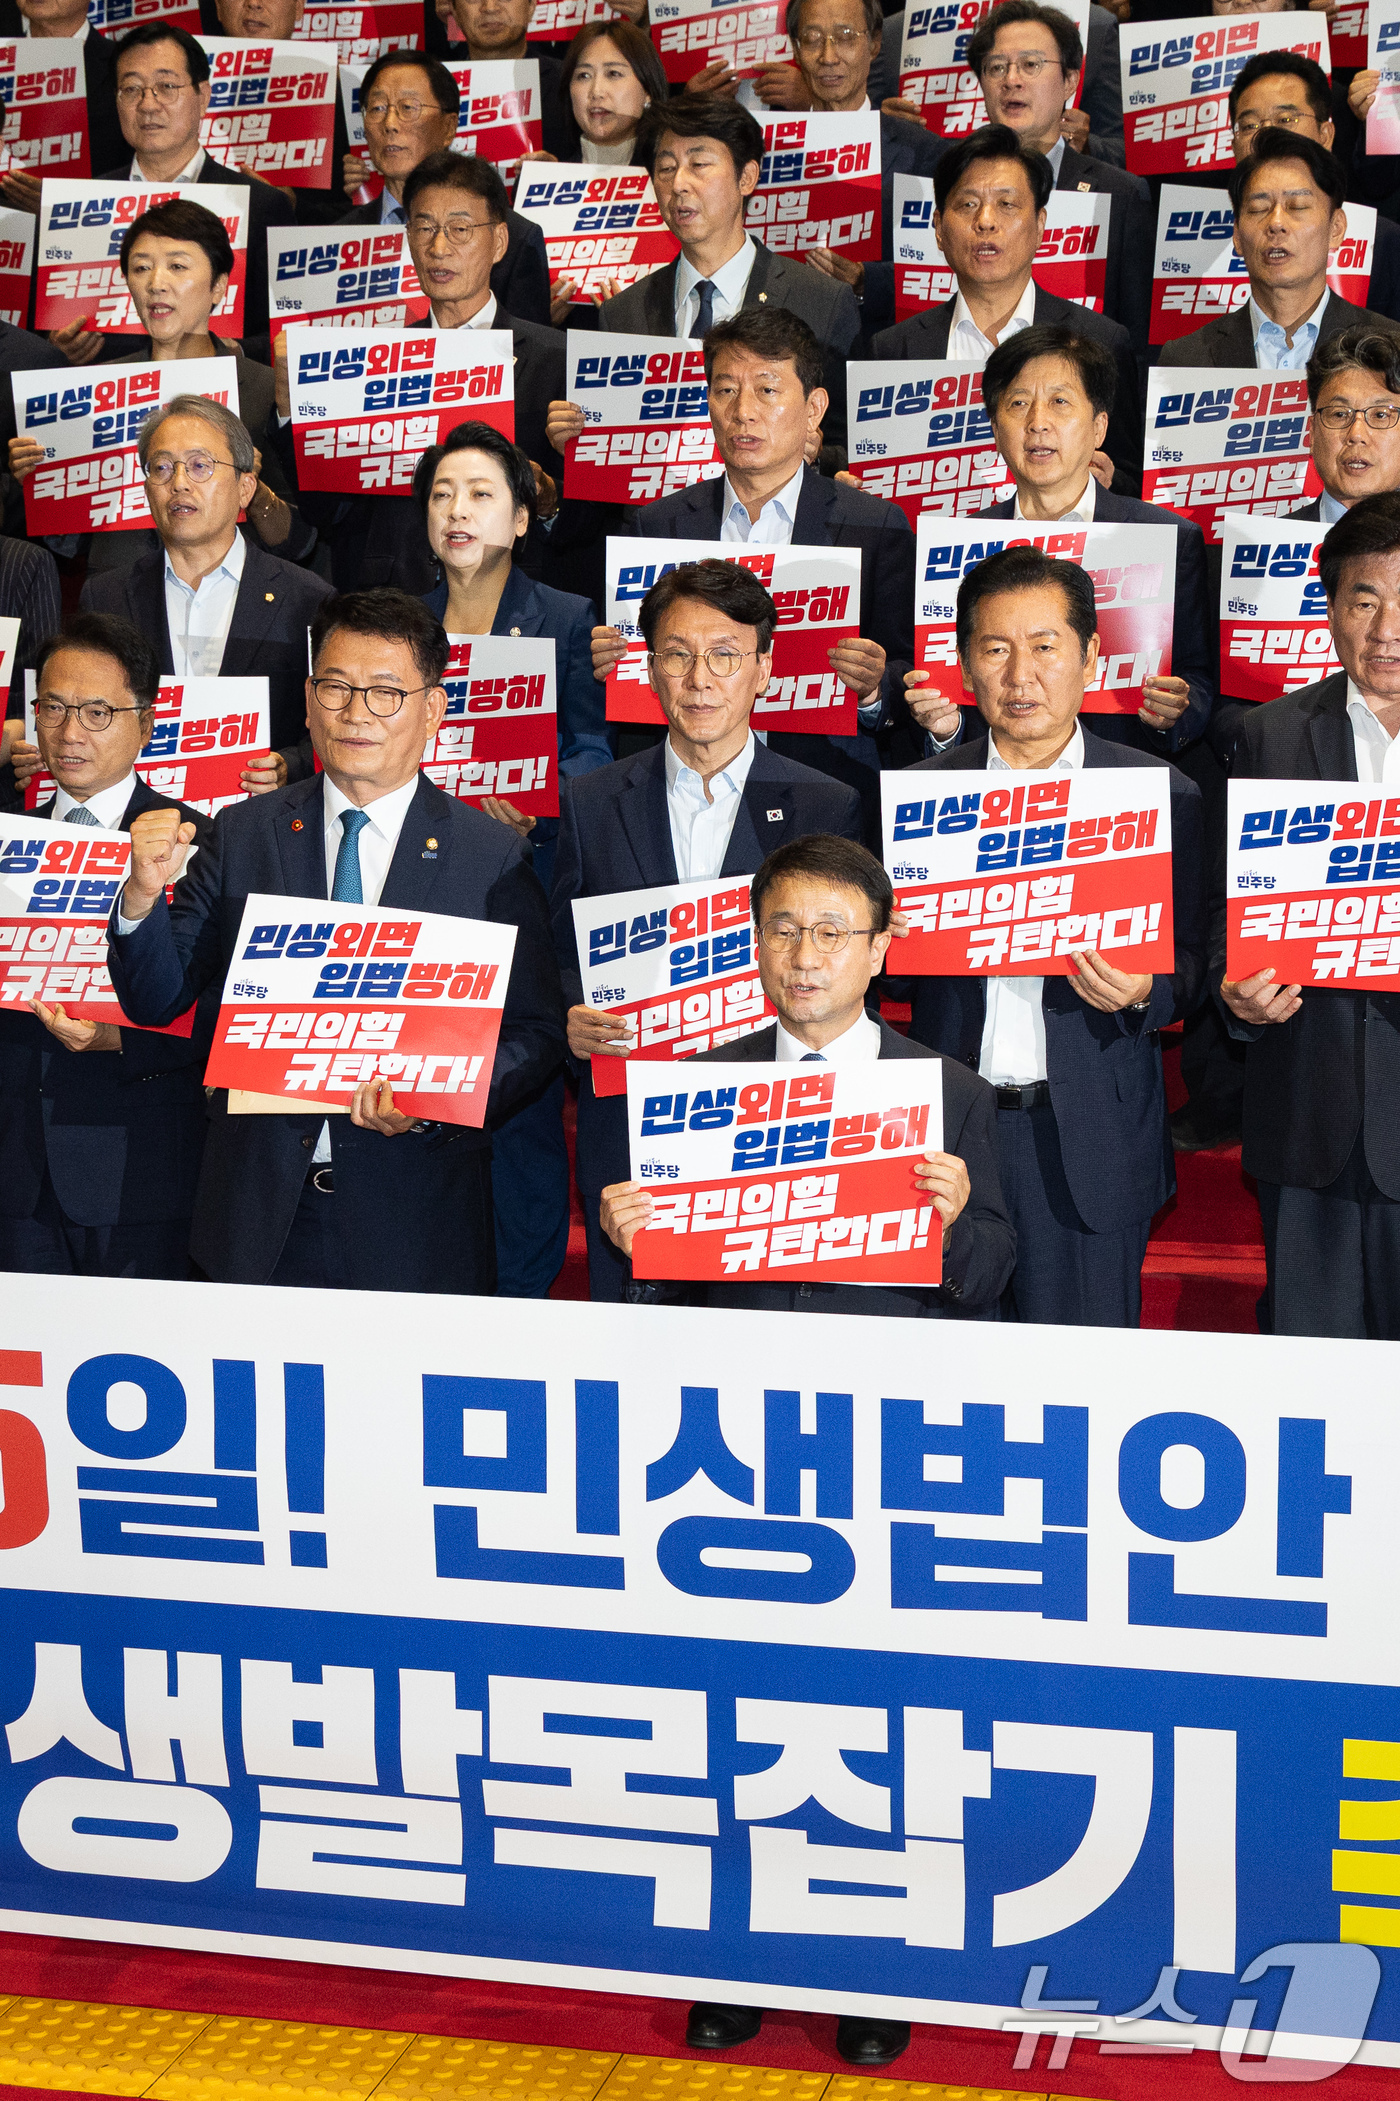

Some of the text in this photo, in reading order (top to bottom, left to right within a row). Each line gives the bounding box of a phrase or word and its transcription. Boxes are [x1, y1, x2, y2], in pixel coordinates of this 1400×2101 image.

[660, 5, 779, 53] 국민의힘
[907, 0, 1000, 40] 민생외
[208, 47, 274, 78] 외면
[1129, 21, 1260, 76] 민생외면
[207, 72, 329, 108] 입법방해
[1129, 94, 1156, 105] 민주당
[1133, 98, 1232, 143] 국민의
[522, 175, 649, 208] 민생외면
[45, 250, 73, 260] 민주당
[276, 232, 404, 281] 민생외면
[899, 247, 925, 261] 민주당
[1161, 261, 1191, 274] 민주당
[275, 299, 302, 310] 민주당
[297, 337, 437, 385] 민생외면
[25, 369, 162, 429] 민생외면
[363, 364, 505, 412] 입법방해
[1154, 379, 1309, 429] 민생외면
[298, 405, 327, 417] 민주당
[303, 415, 440, 460] 국민의힘
[574, 428, 716, 467] 국민의힘
[855, 443, 888, 455] 민주당
[1152, 450, 1183, 462] 민주당
[1223, 416, 1312, 457] 입법
[33, 452, 146, 500] 국민의
[861, 450, 1008, 499] 국민의힘
[1152, 460, 1309, 508] 국민의힘
[922, 604, 954, 618] 민주당
[1227, 601, 1259, 616] 민주당
[892, 778, 1072, 842] 민생외면
[0, 839, 132, 876] 생외면
[975, 808, 1159, 873] 입법방해
[892, 865, 929, 880] 민주당
[1237, 875, 1277, 889] 민주당
[26, 878, 121, 915] 입법
[899, 873, 1075, 932] 국민의힘
[241, 921, 423, 960] 민생외면
[589, 885, 751, 968] 민생외면
[966, 902, 1164, 969] 규탄한다!
[669, 927, 760, 987] 입법
[233, 983, 269, 999] 민주당
[313, 961, 499, 1000] 입법방해
[591, 987, 626, 1004] 민주당
[224, 1011, 407, 1050] 국민의힘
[284, 1052, 486, 1094] 규탄한다!
[640, 1071, 836, 1137] 민생외면
[731, 1104, 931, 1172] 입법방해
[640, 1163, 681, 1179] 민주당
[645, 1173, 839, 1235] 국민의힘
[720, 1206, 933, 1274] 규탄한다!
[421, 1374, 1353, 1638] 민생법안
[4, 1641, 1238, 1975] 생발목잡기
